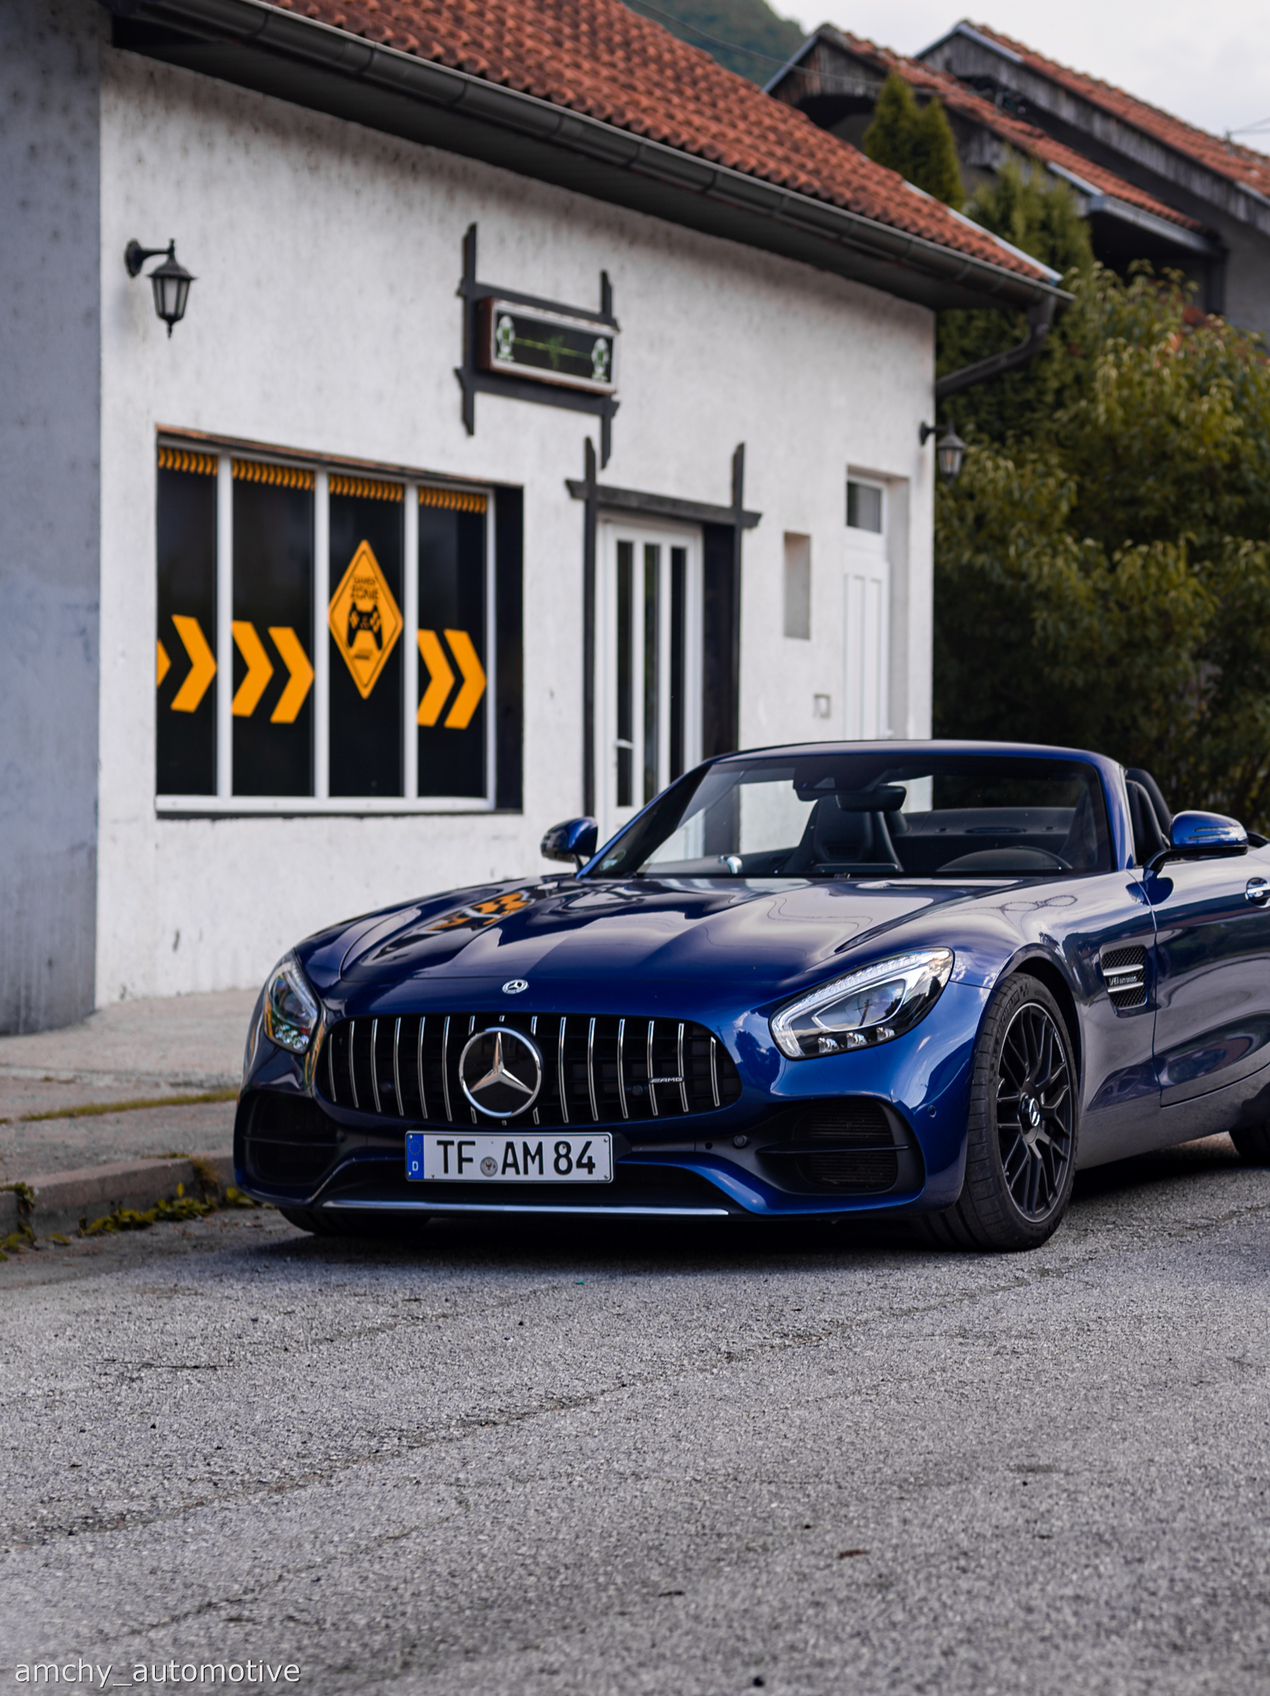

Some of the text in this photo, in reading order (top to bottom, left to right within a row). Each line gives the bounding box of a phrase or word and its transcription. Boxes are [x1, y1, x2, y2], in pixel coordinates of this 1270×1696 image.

[411, 1160, 419, 1172] D
[436, 1140, 596, 1175] TF AM 84
